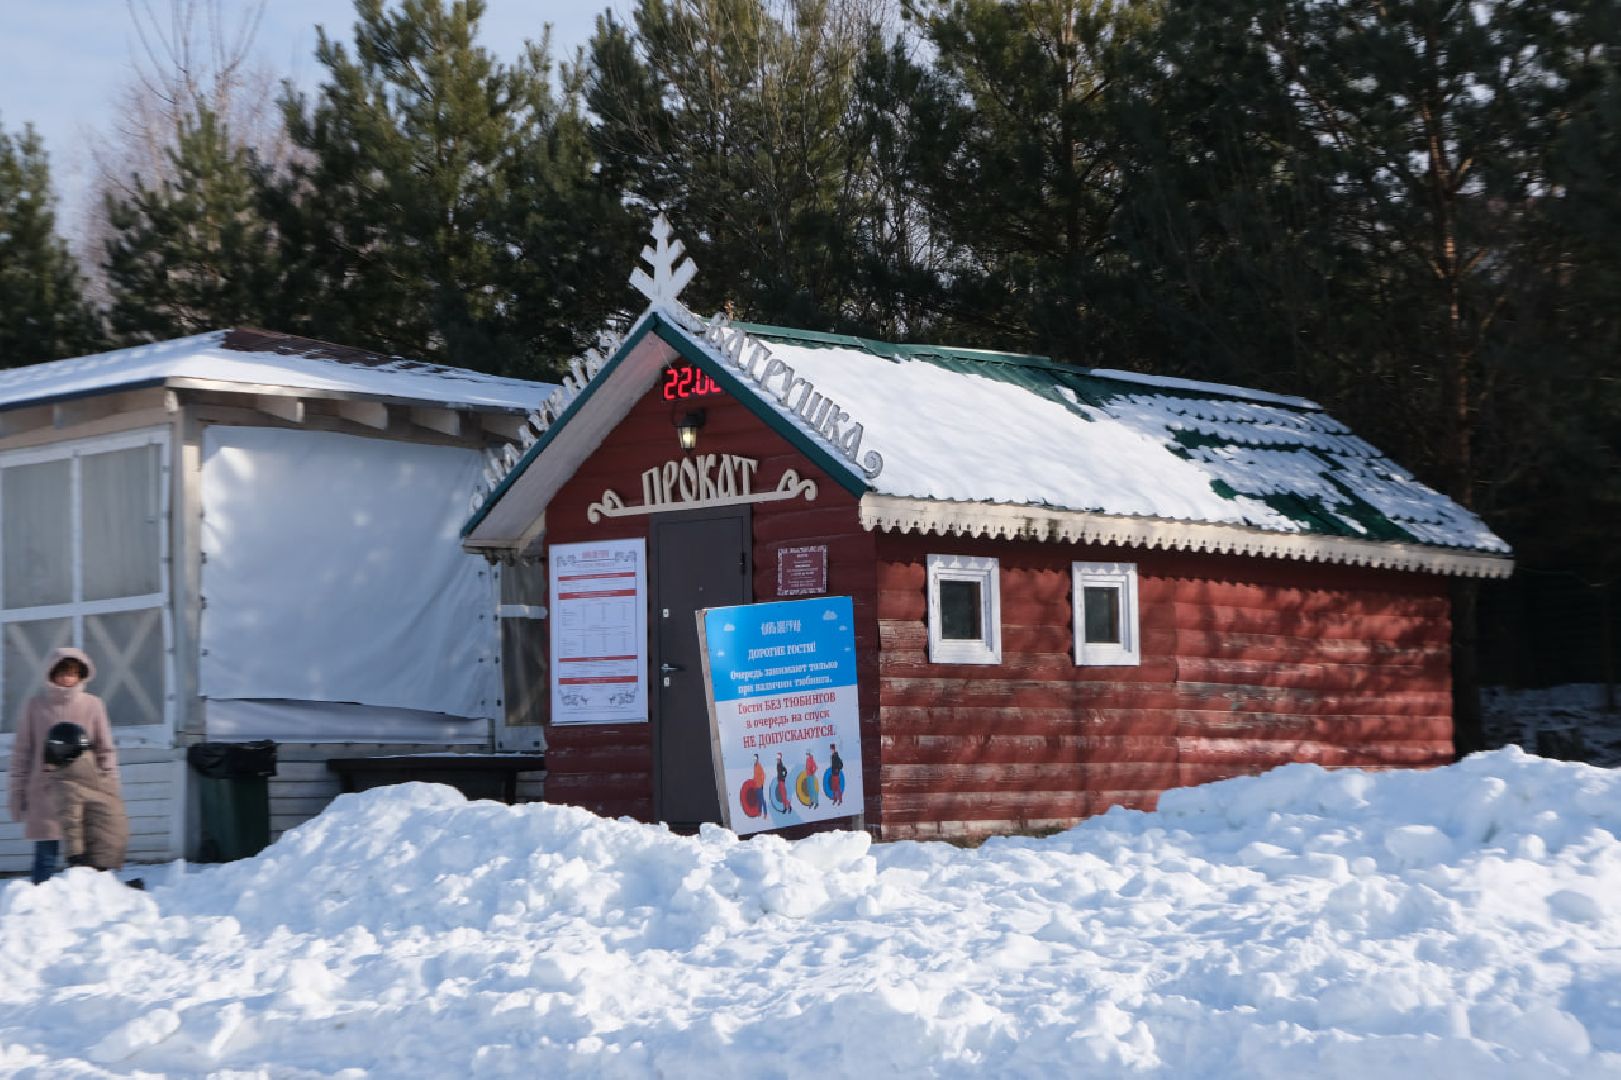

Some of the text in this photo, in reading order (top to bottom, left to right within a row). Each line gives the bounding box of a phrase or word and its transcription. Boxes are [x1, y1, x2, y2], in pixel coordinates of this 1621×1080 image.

[641, 453, 759, 506] ПРОКАТ
[748, 646, 785, 661] ДОРОГИЕ
[738, 692, 836, 714] Гости БЕЗ ТЮБИНГОВ
[753, 715, 789, 729] очередь
[791, 713, 802, 722] на
[804, 709, 830, 722] спуск
[743, 735, 757, 749] НЕ
